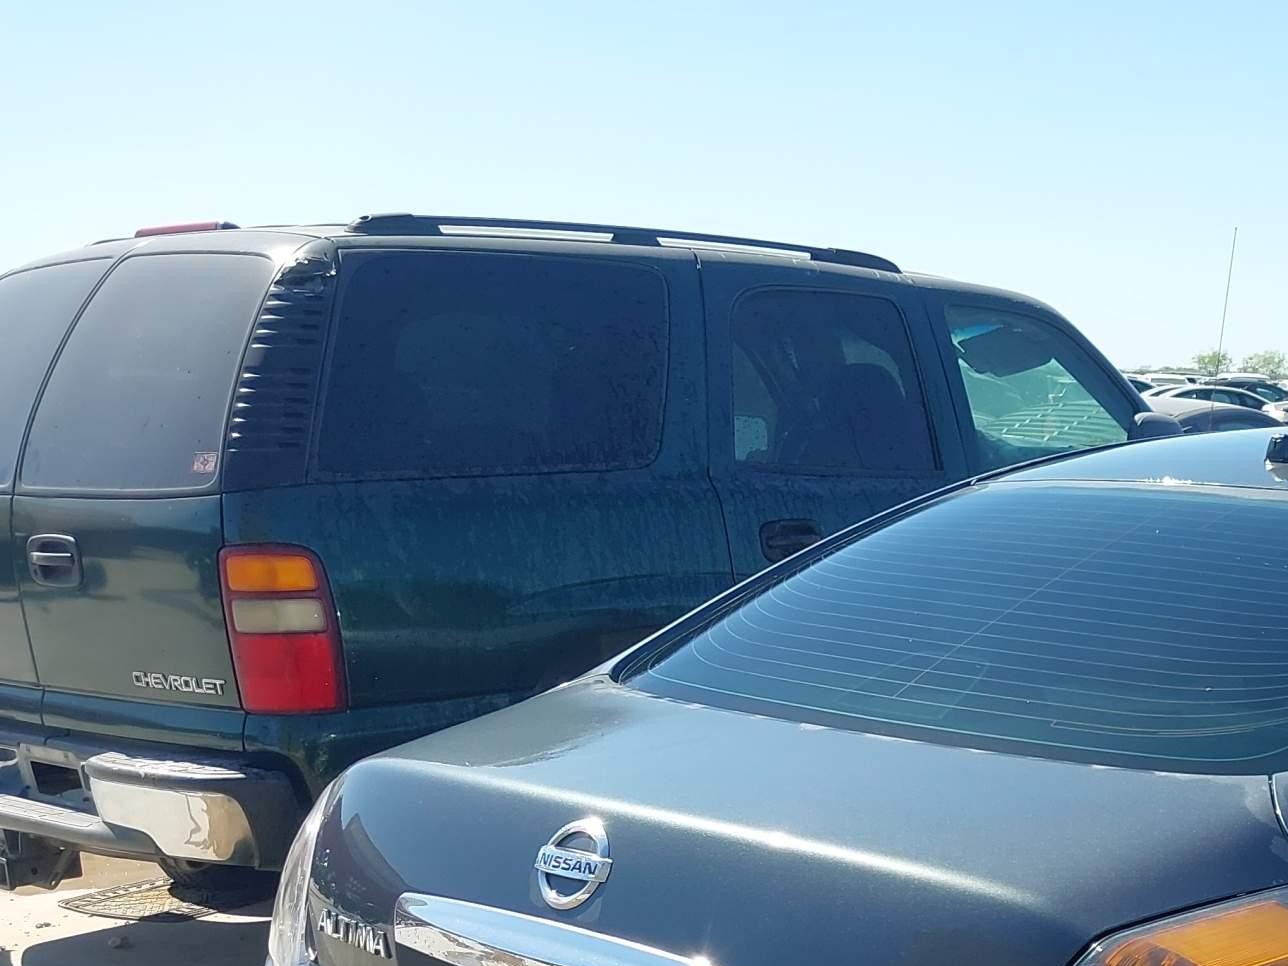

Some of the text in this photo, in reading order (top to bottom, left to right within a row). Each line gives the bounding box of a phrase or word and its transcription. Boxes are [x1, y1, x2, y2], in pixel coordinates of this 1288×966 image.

[132, 671, 225, 696] CHEVROLET
[539, 851, 599, 876] NISSAN
[317, 907, 392, 959] ALTIMA
